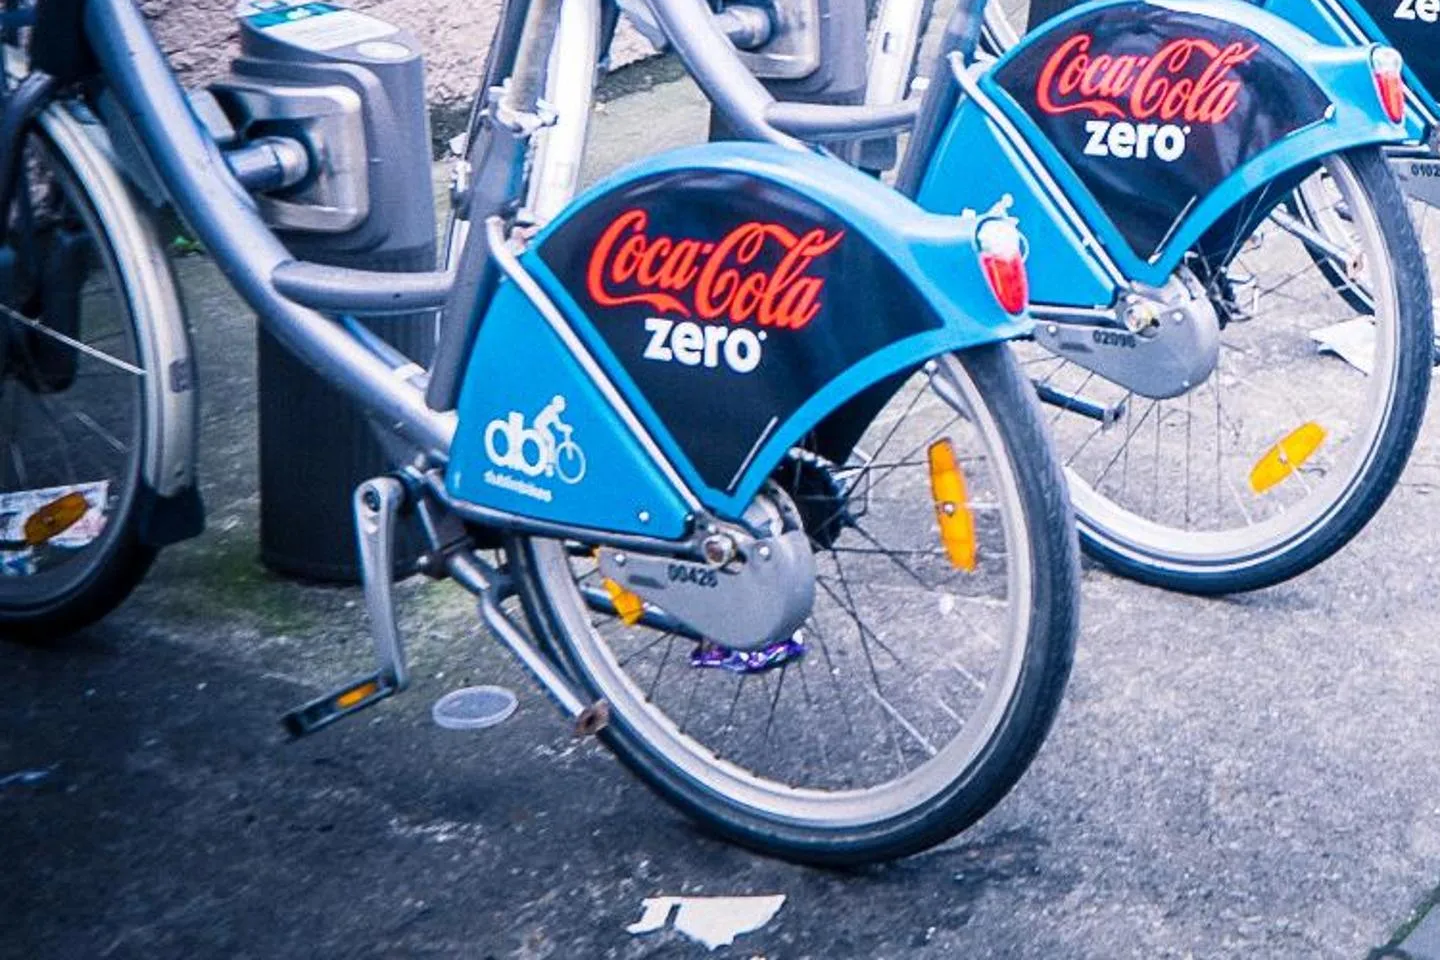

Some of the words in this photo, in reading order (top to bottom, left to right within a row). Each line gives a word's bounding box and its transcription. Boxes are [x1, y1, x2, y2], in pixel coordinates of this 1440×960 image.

[1036, 33, 1261, 123] Coca-Cola
[1083, 119, 1191, 162] zero
[586, 208, 846, 330] Coca-Cola
[643, 317, 767, 373] zero
